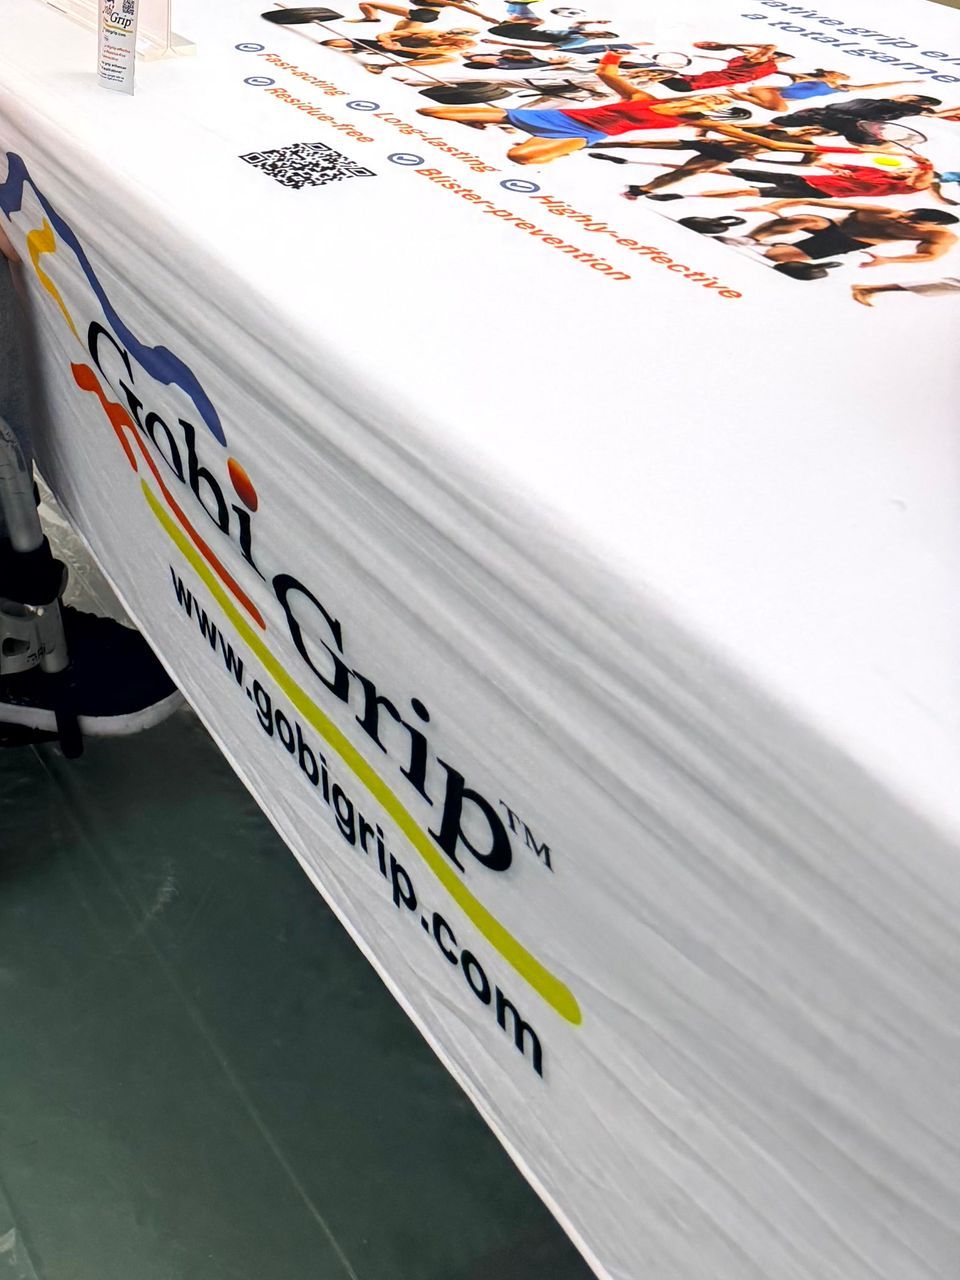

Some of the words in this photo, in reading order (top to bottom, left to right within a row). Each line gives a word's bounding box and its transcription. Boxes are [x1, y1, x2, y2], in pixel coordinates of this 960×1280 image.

[768, 20, 861, 44] total
[842, 48, 960, 84] game
[836, 27, 919, 50] grip
[257, 53, 351, 97] Fast-acting
[373, 112, 501, 174] Long-lasting
[529, 195, 743, 301] Highly-effective
[264, 87, 375, 143] Residue-free
[414, 167, 632, 281] Blister-prevention
[169, 564, 543, 1077] www.gobigrip.com
